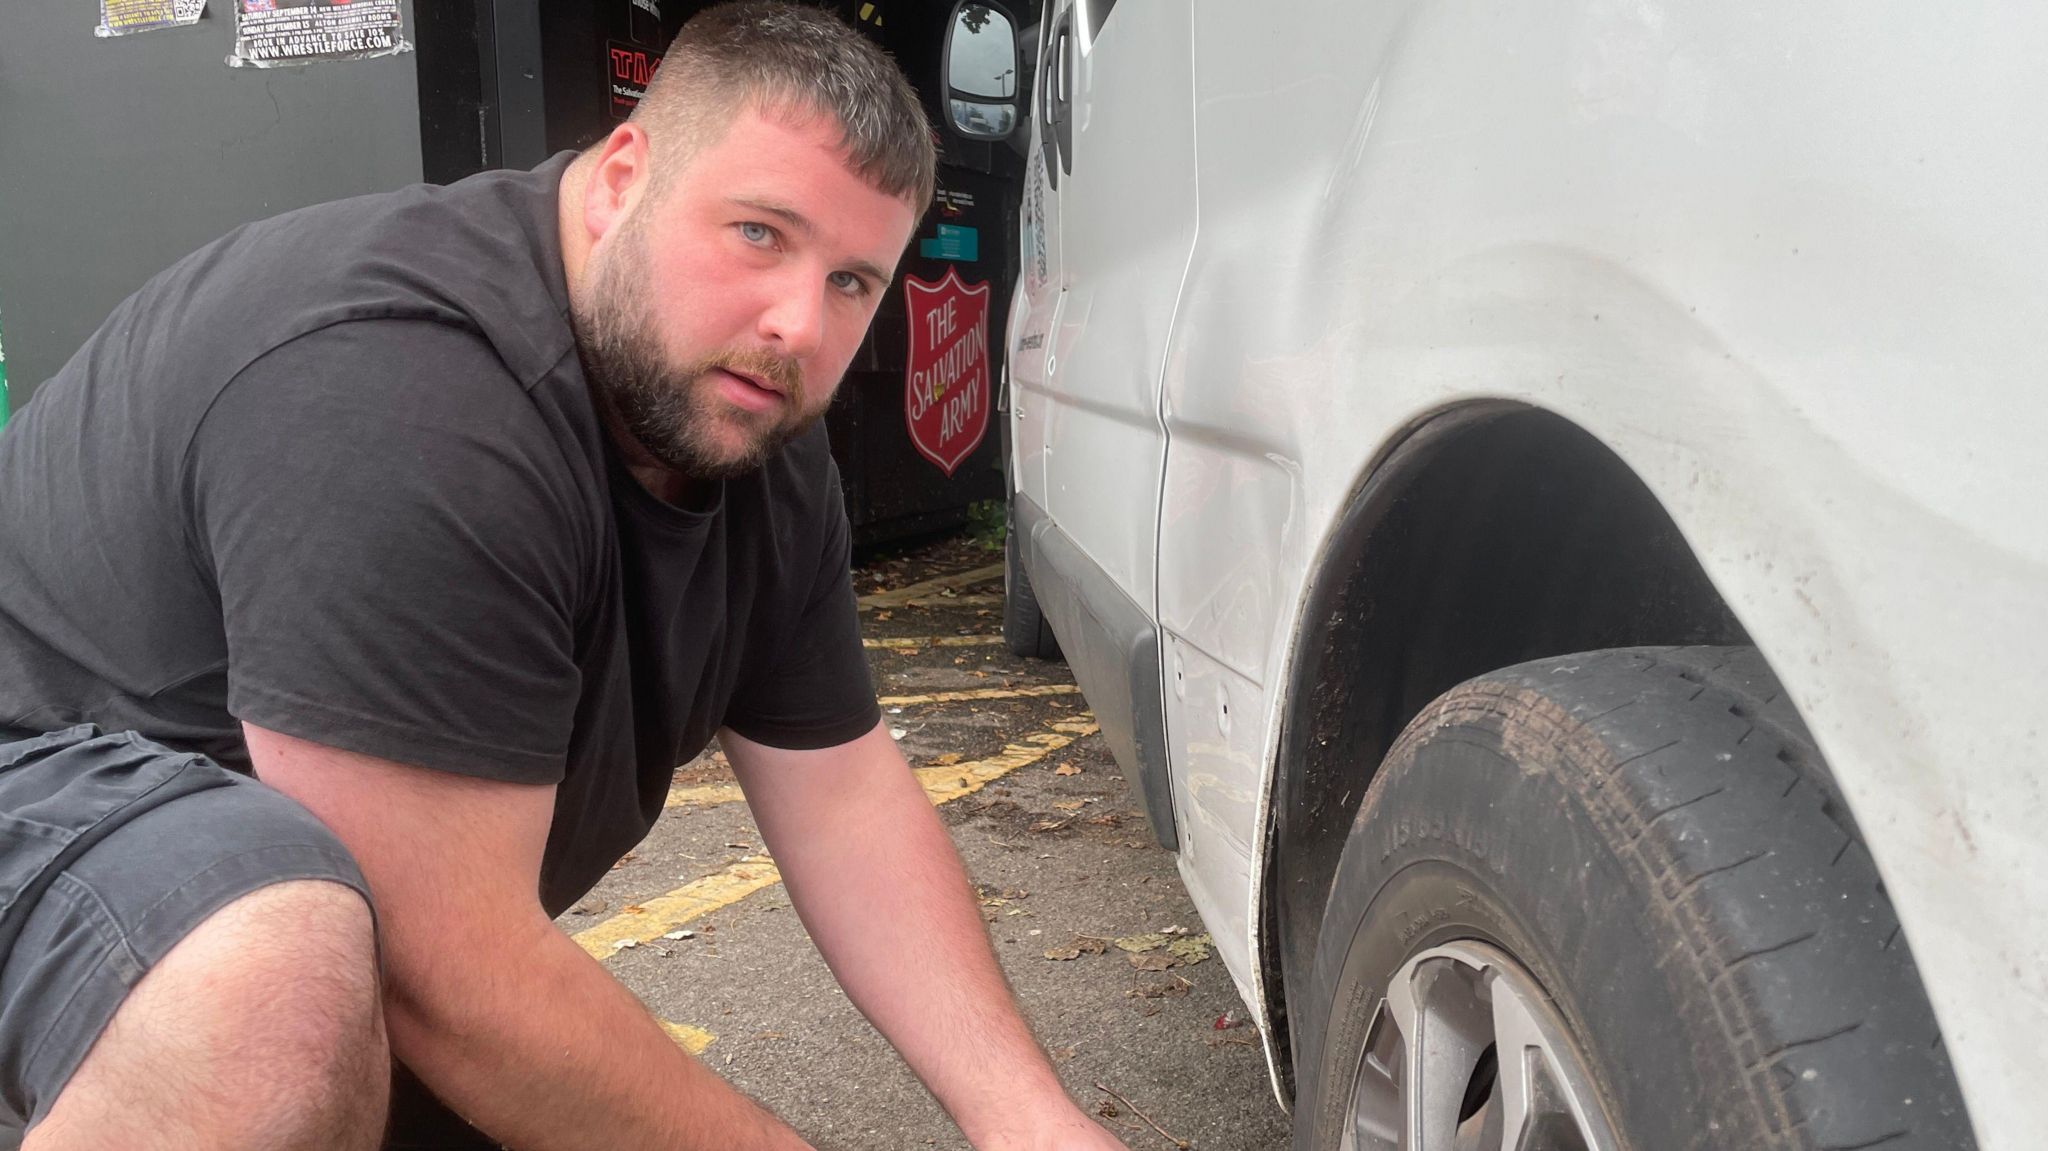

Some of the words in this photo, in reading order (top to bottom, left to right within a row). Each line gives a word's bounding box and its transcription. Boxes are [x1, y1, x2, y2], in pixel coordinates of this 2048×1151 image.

[242, 11, 271, 21] SATURDAY
[272, 6, 309, 18] SEPTEMBER
[266, 21, 302, 32] SEPTEMBER
[315, 19, 336, 27] ALTON
[368, 13, 391, 22] ROOMS
[253, 38, 273, 48] BOOK
[276, 37, 285, 46] IN
[288, 33, 327, 45] ADVANCE
[331, 32, 342, 41] TO
[345, 29, 365, 39] SAVE
[368, 27, 385, 37] 10%
[926, 296, 957, 351] THE
[912, 309, 984, 421] SALVATION
[939, 367, 981, 448] ARMY
